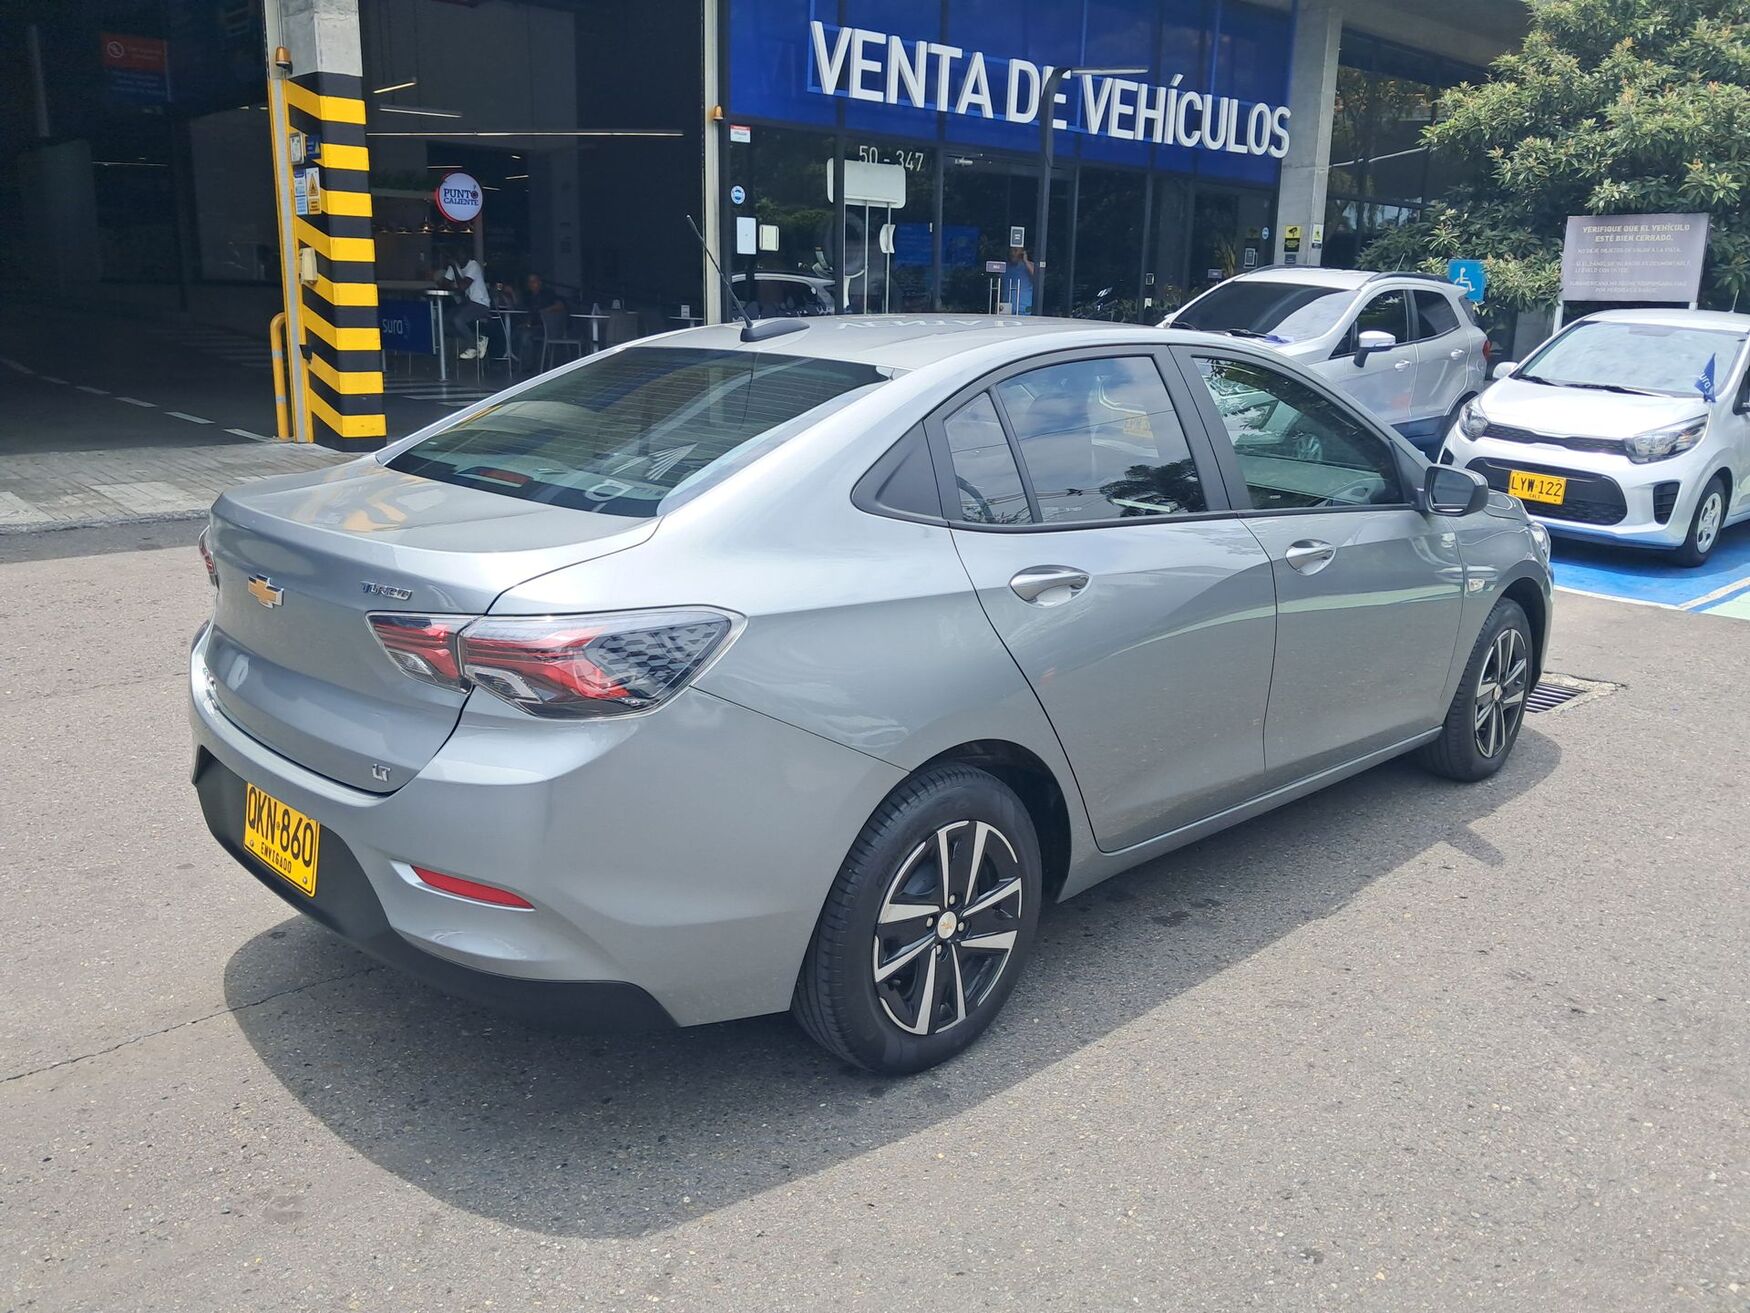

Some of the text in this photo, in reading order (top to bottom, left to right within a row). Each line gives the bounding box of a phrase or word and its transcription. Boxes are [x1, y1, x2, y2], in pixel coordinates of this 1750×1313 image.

[811, 20, 1292, 159] VENTA DE VEHÍCULOS
[859, 145, 878, 164] 50
[896, 150, 924, 171] 347
[443, 188, 479, 200] PUNTO
[443, 198, 479, 206] CALIENTE
[1583, 225, 1622, 233] VERIFIQUE
[1651, 223, 1690, 231] VEHÍCULO
[382, 319, 403, 335] sura
[1511, 476, 1563, 497] LYW 122
[371, 763, 391, 782] LT
[247, 786, 314, 868] QKN 860
[261, 841, 292, 874] ENVIGADO
